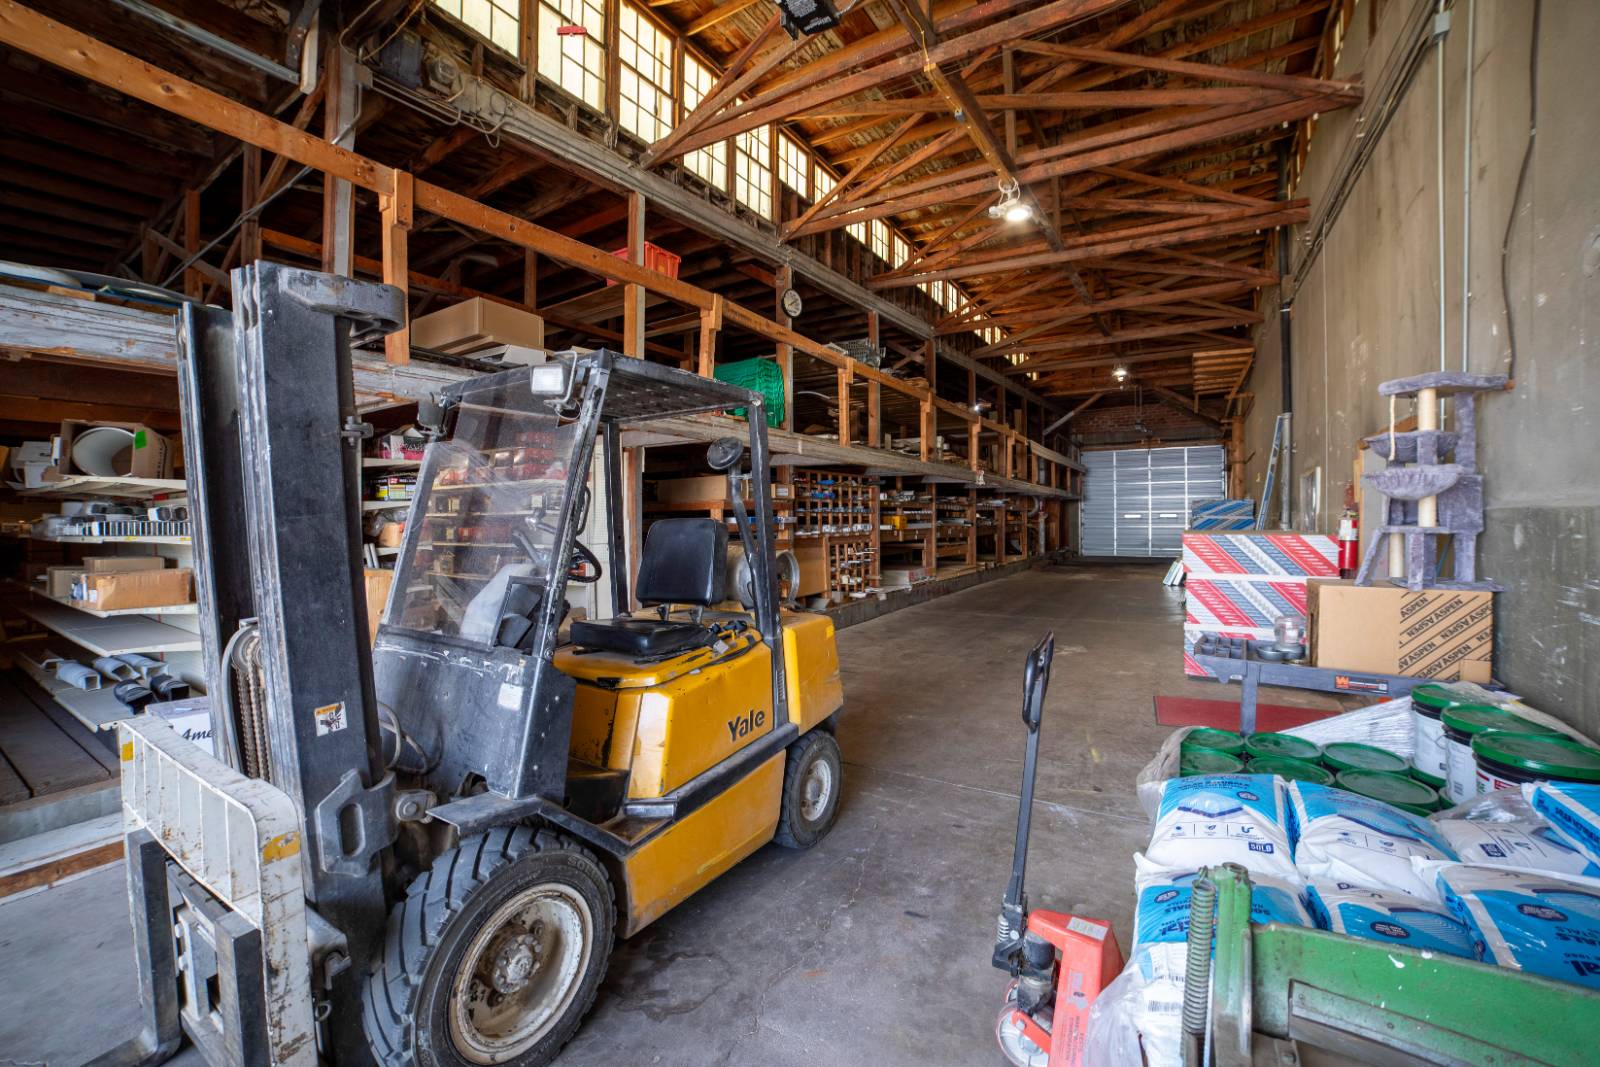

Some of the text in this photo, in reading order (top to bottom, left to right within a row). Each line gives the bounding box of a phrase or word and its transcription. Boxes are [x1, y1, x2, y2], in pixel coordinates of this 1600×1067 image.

[1400, 596, 1428, 618] ASPEN
[1434, 598, 1463, 620] ASPEN
[1406, 616, 1434, 637] ASPEN
[1440, 618, 1469, 640] ASPEN
[1408, 641, 1436, 661] ASPEN
[1442, 643, 1472, 665] ASPEN
[727, 709, 765, 742] Yale
